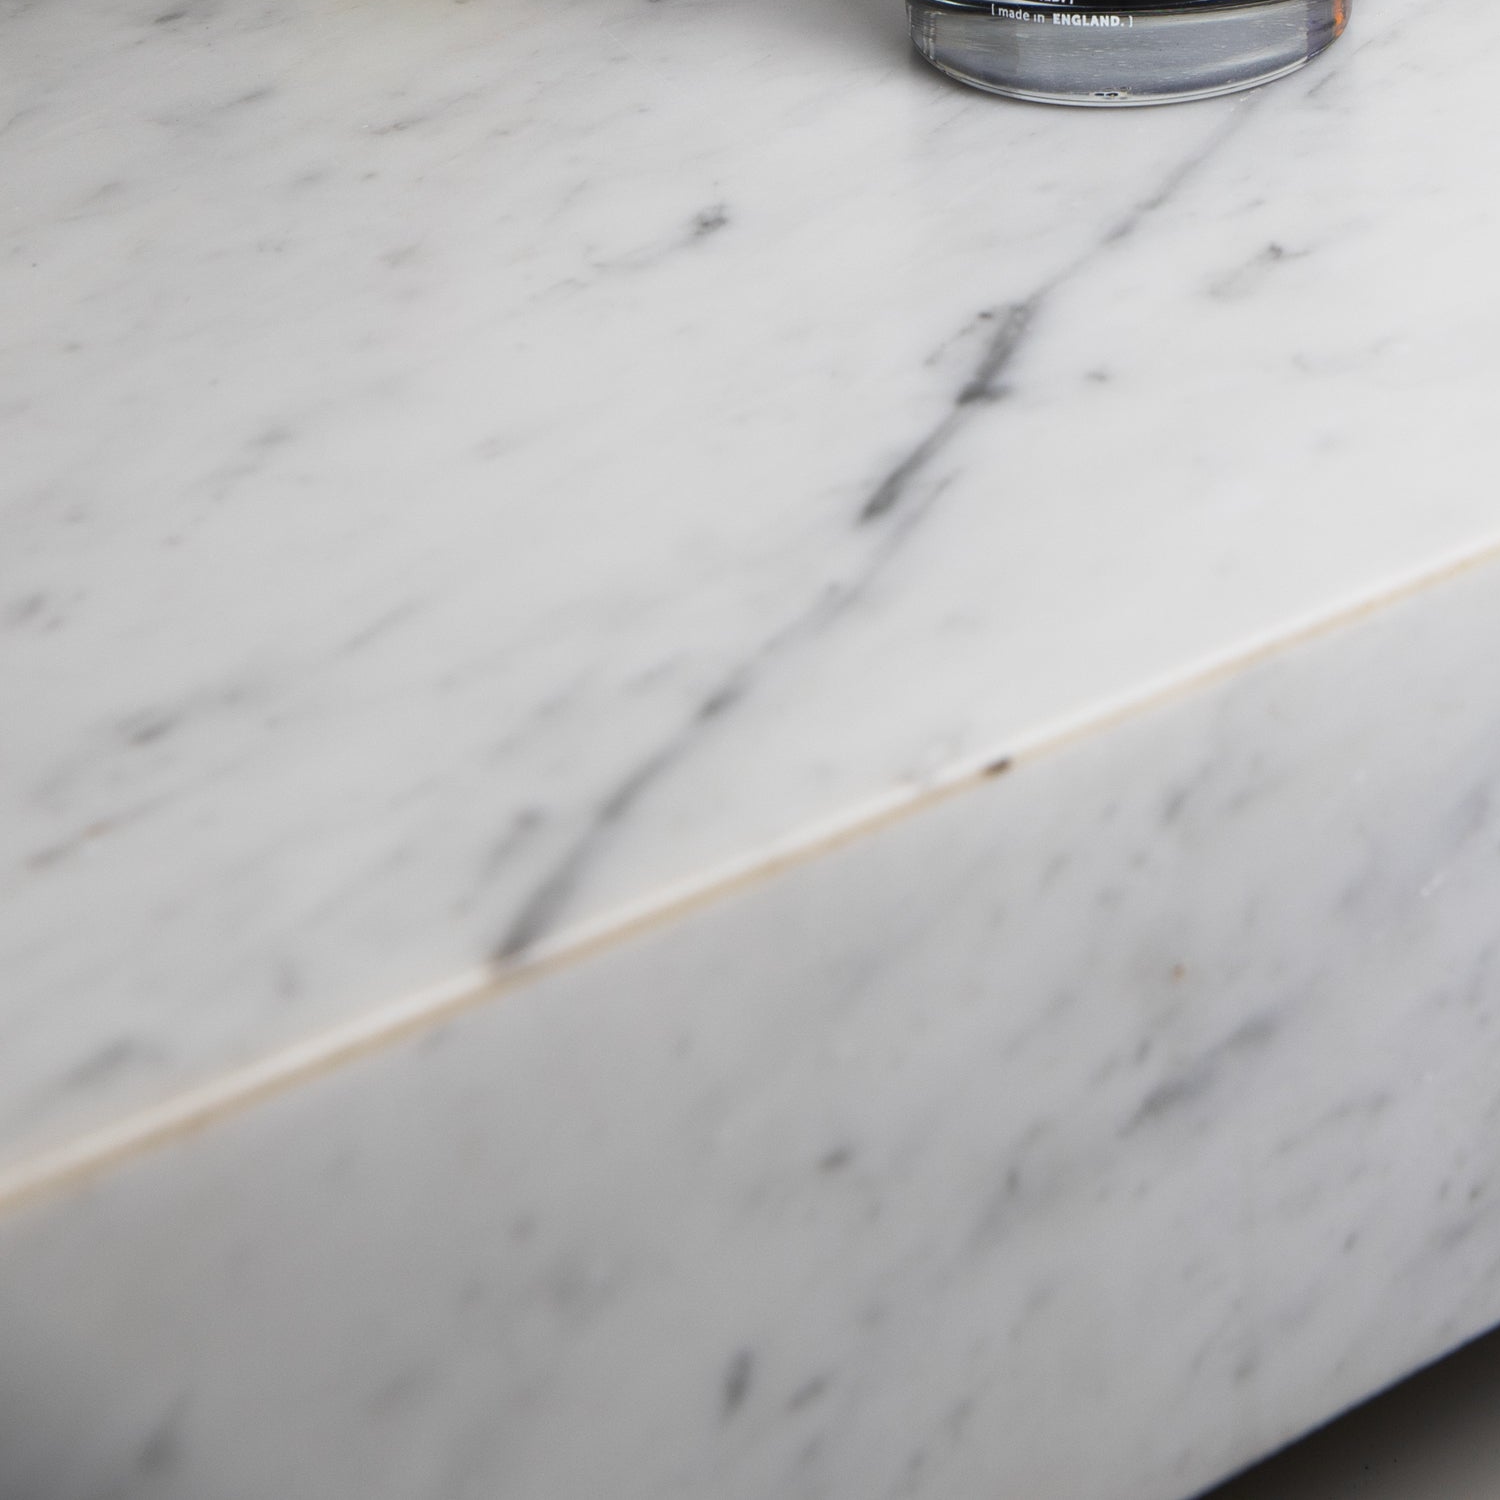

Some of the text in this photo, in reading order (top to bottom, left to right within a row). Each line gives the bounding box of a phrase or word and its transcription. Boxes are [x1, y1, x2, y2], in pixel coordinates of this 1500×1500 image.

[998, 6, 1030, 21] made
[1033, 13, 1045, 23] in
[1053, 13, 1125, 27] ENGLAND.
